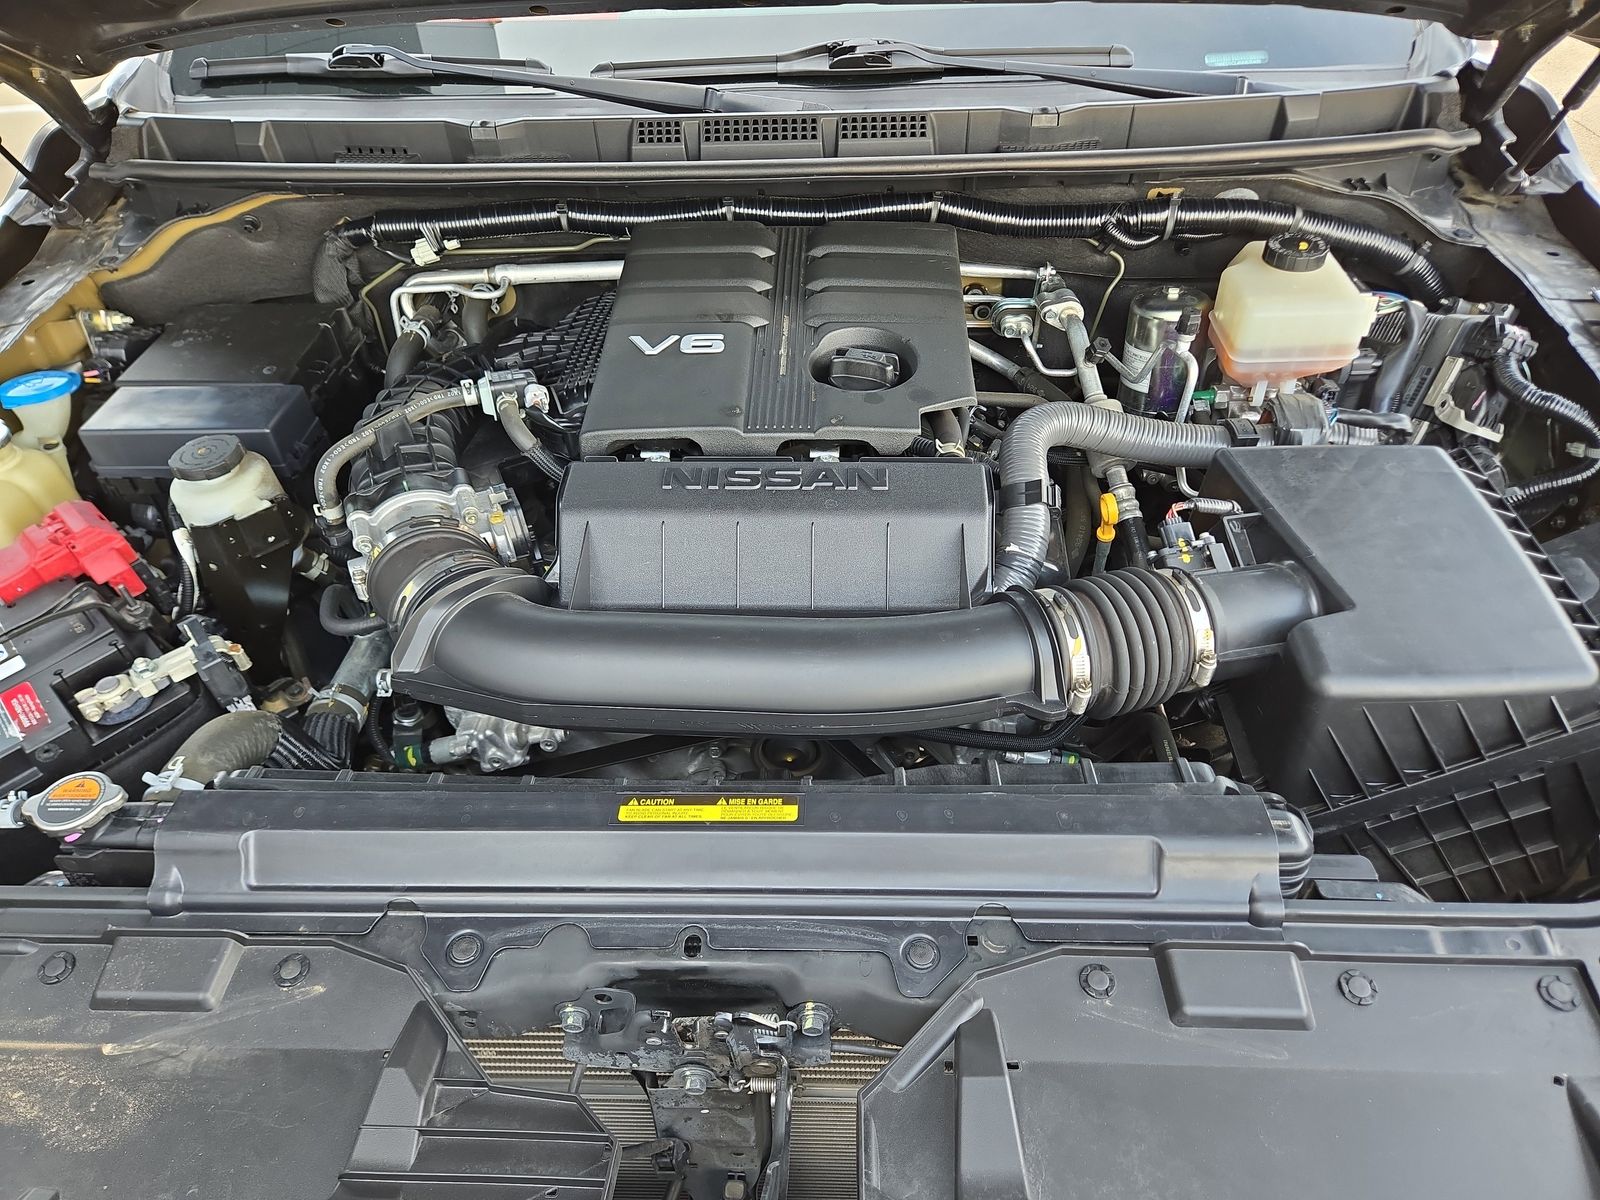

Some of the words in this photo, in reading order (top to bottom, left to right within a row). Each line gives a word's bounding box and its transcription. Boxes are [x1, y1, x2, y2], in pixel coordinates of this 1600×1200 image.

[628, 333, 725, 355] V6
[662, 467, 889, 491] NISSAN
[640, 798, 675, 806] CAUTION
